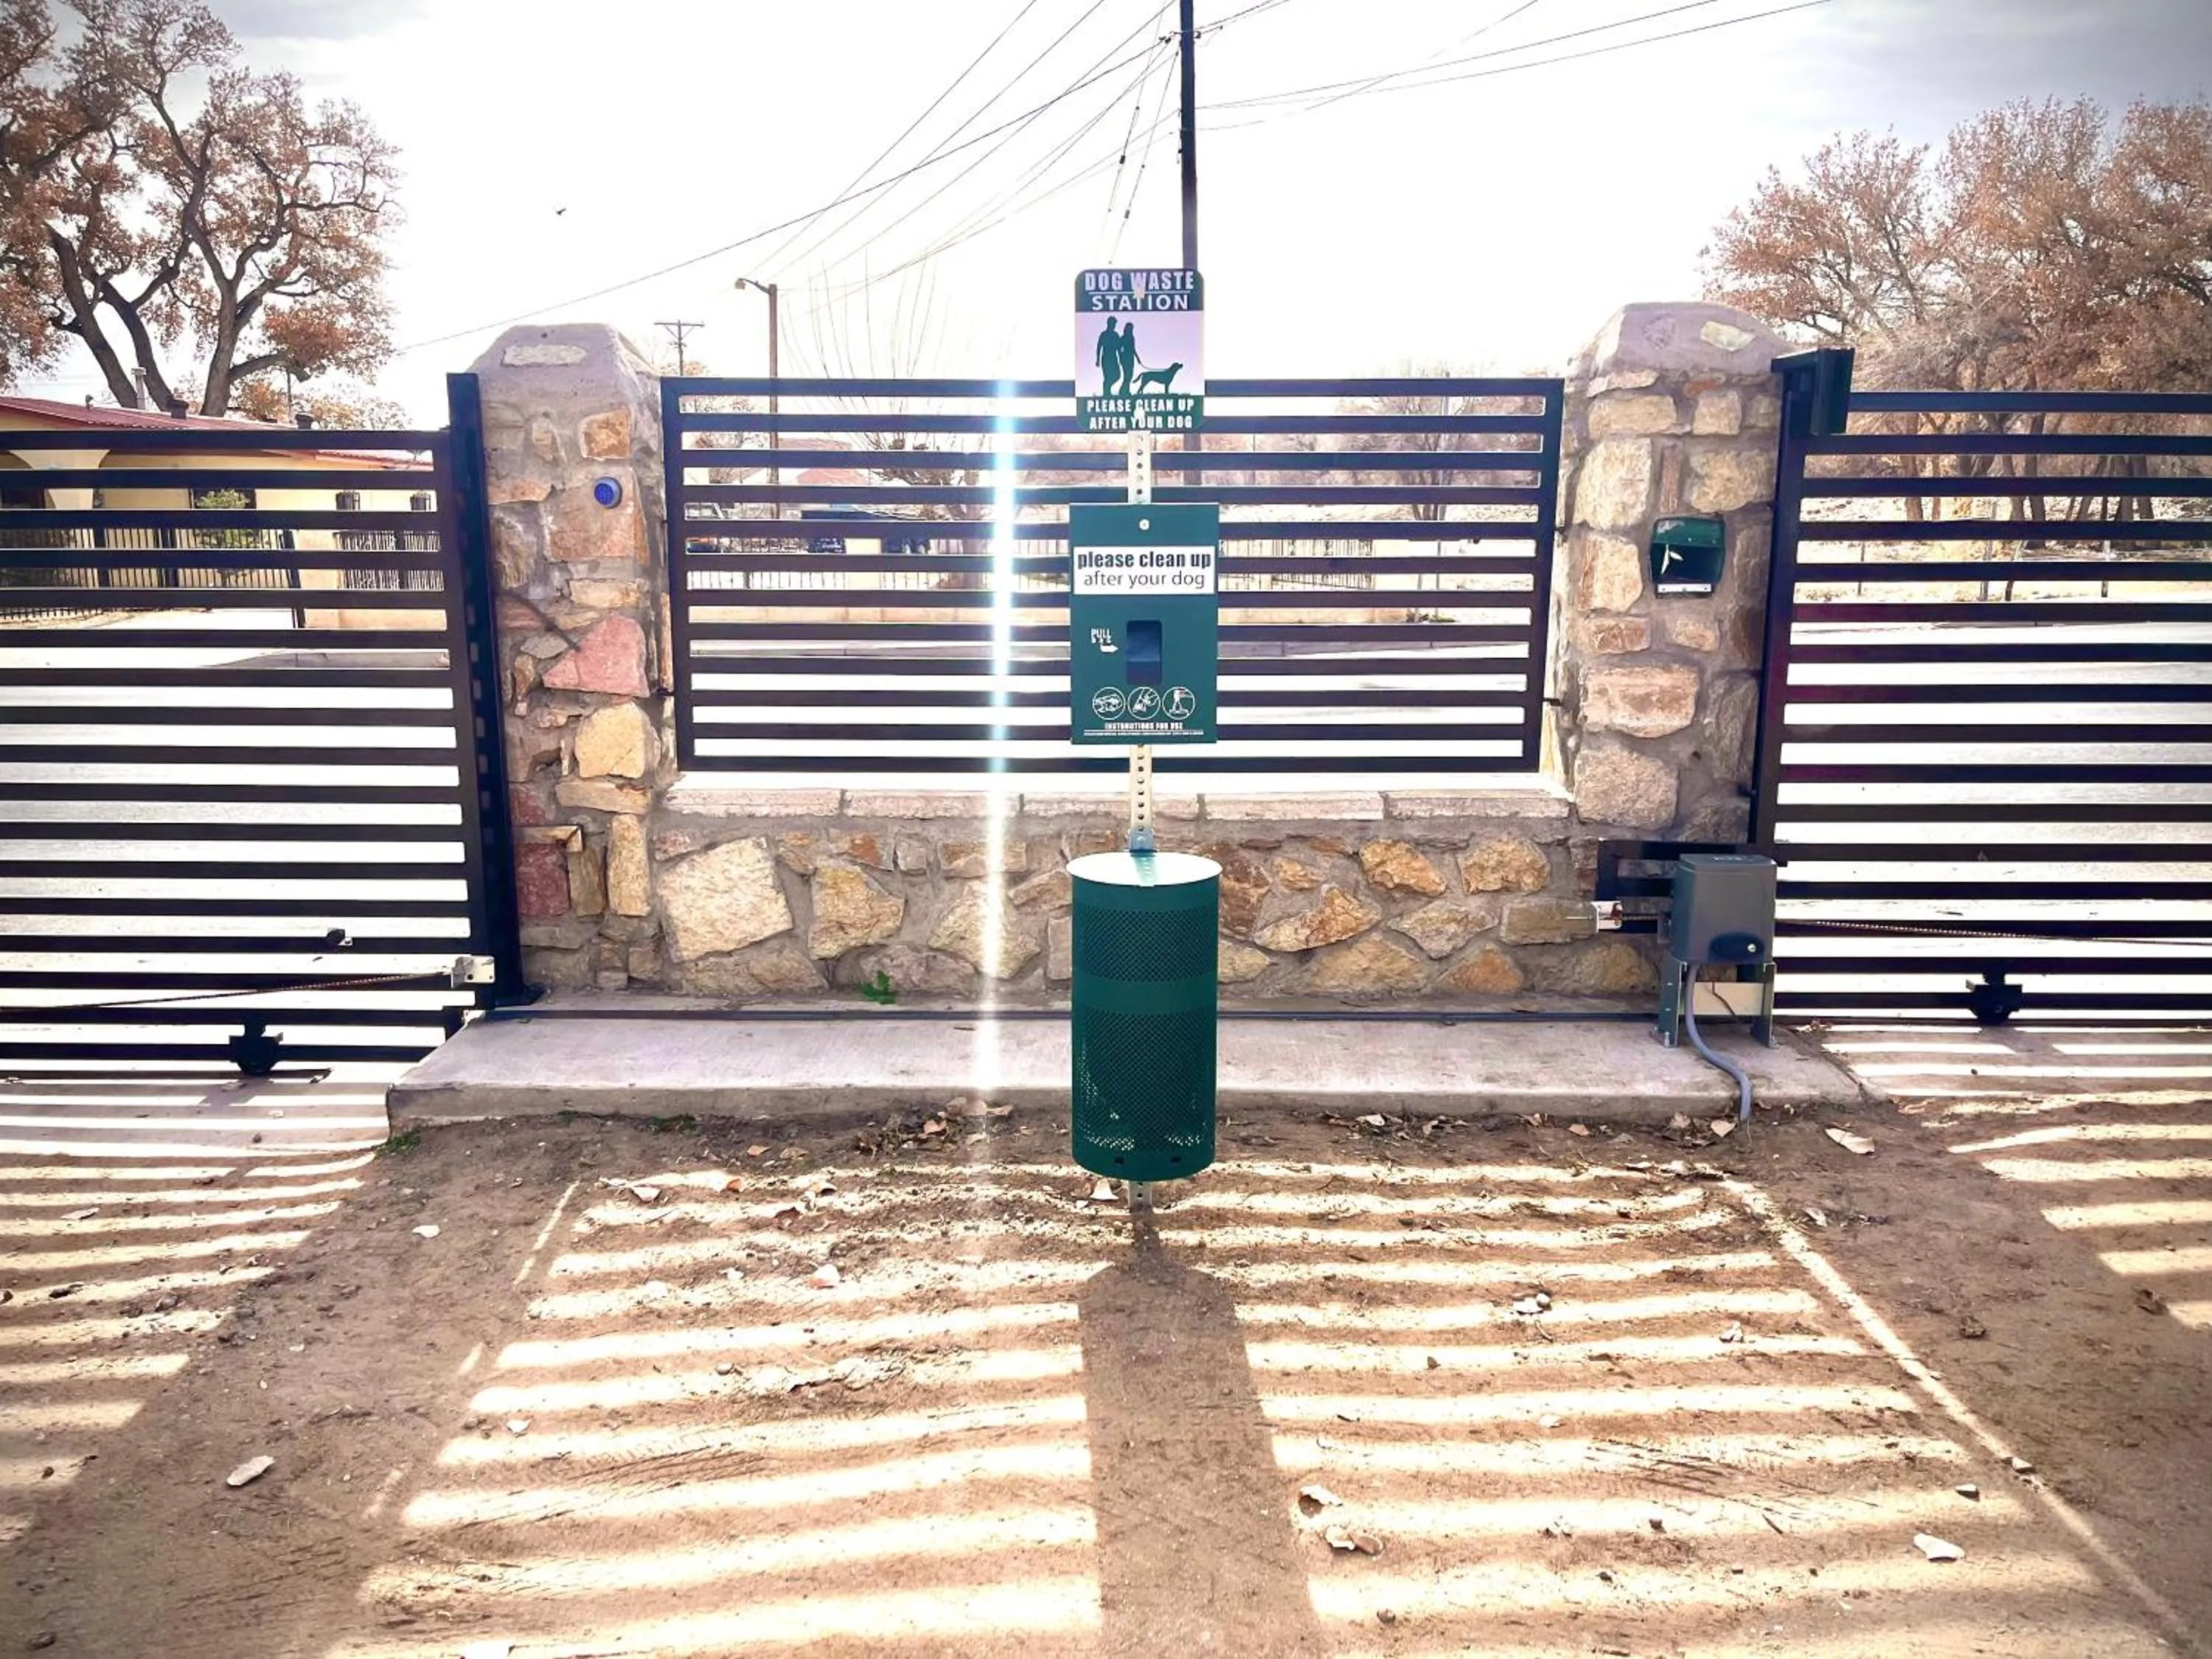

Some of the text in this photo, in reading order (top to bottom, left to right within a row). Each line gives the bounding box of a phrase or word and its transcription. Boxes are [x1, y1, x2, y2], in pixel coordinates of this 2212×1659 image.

[1085, 271, 1194, 291] DOG WASTE
[1092, 294, 1188, 310] STATION
[1087, 398, 1194, 412] PLEASE CLEAN UP
[1089, 415, 1192, 429] AFTER YOUR DOG
[1077, 552, 1211, 569] please clean up
[1084, 571, 1205, 589] after your dog
